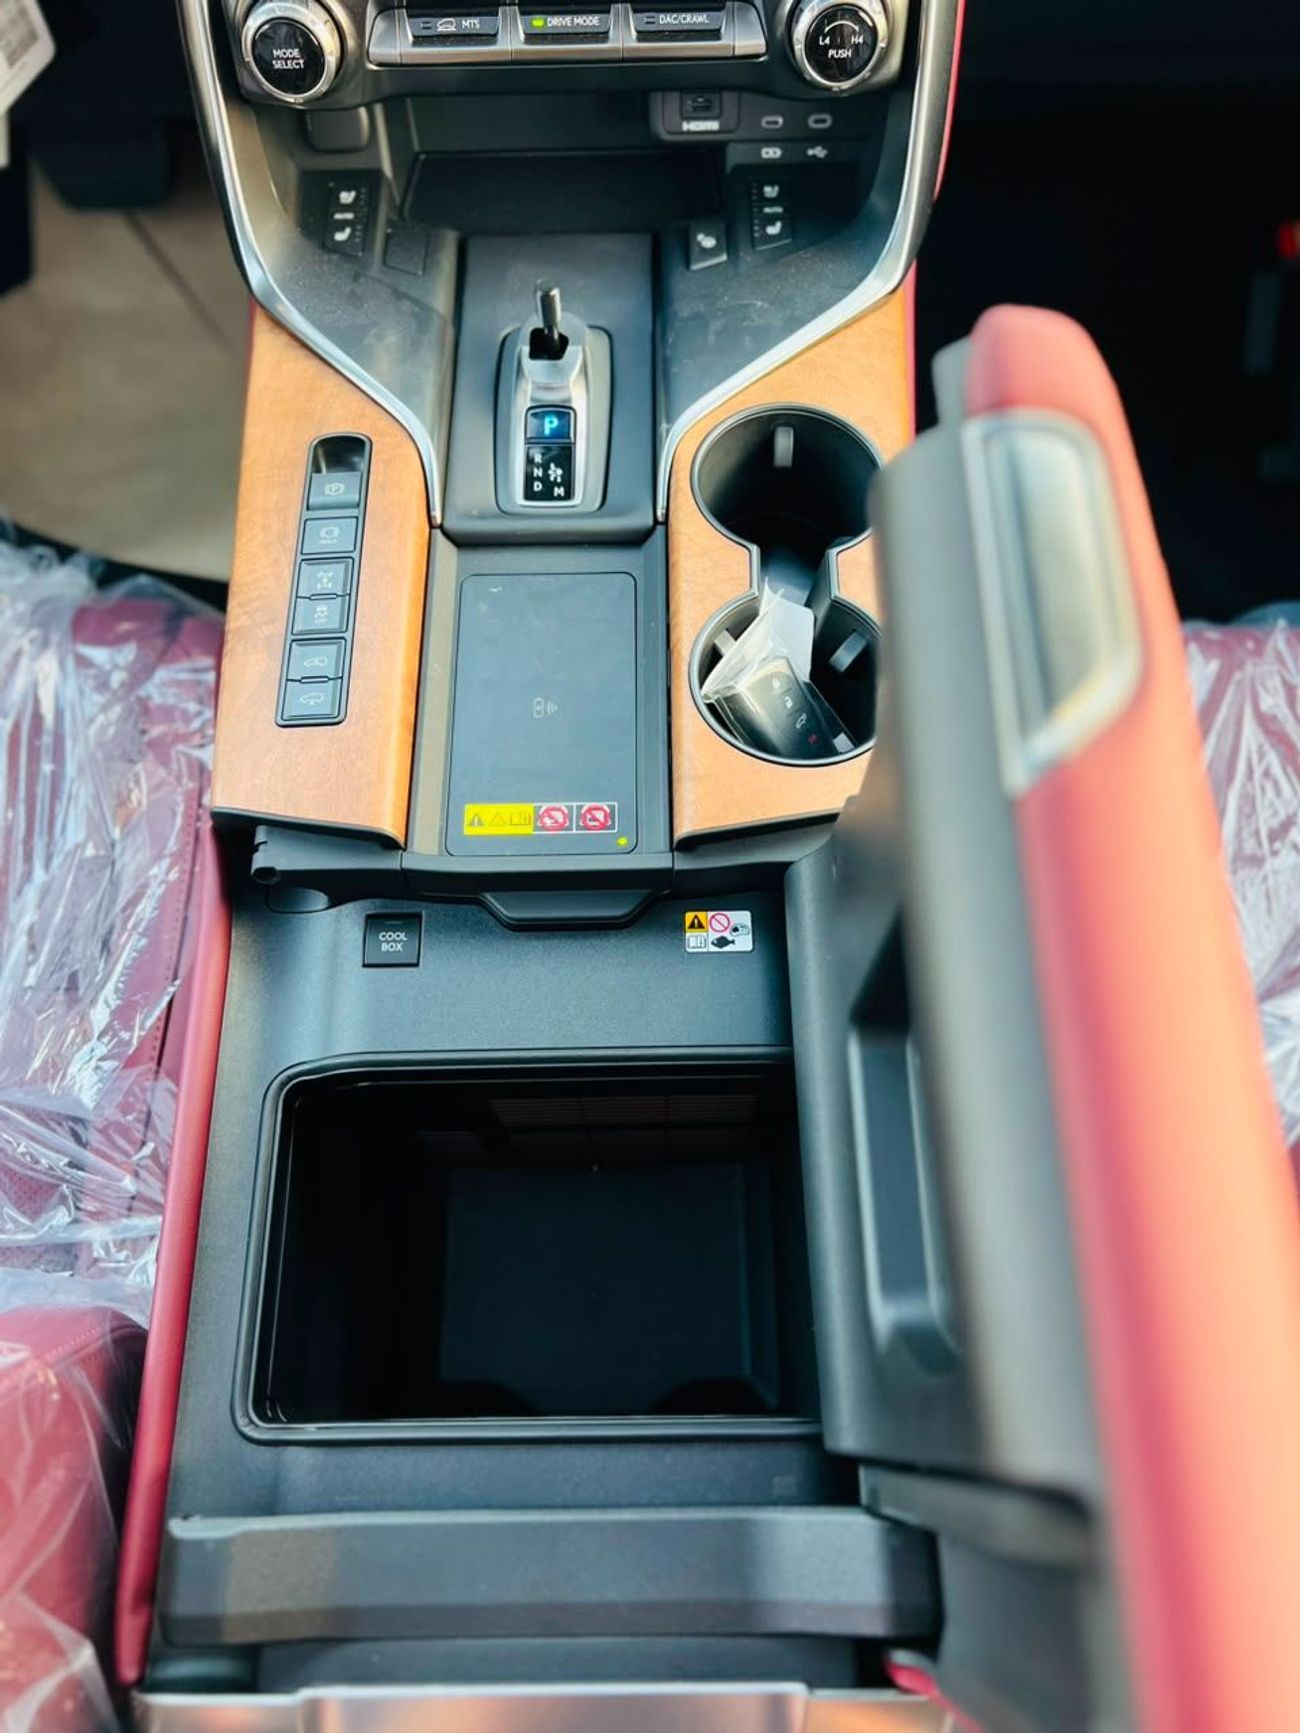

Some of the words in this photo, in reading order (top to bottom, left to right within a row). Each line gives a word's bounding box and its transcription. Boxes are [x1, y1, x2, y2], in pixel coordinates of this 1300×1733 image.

[461, 19, 480, 29] MTS
[547, 17, 573, 27] DRIVE
[574, 16, 600, 26] MODE
[659, 14, 710, 25] DAC/CRAWL
[819, 35, 830, 45] L4
[851, 34, 864, 45] H4
[272, 48, 301, 58] MODE
[827, 49, 852, 59] PUSH
[272, 59, 305, 69] SELECT
[543, 415, 559, 436] P
[533, 467, 543, 478] N
[533, 481, 543, 492] D
[553, 486, 565, 497] M
[379, 931, 408, 941] COOL
[381, 942, 403, 952] BOX
